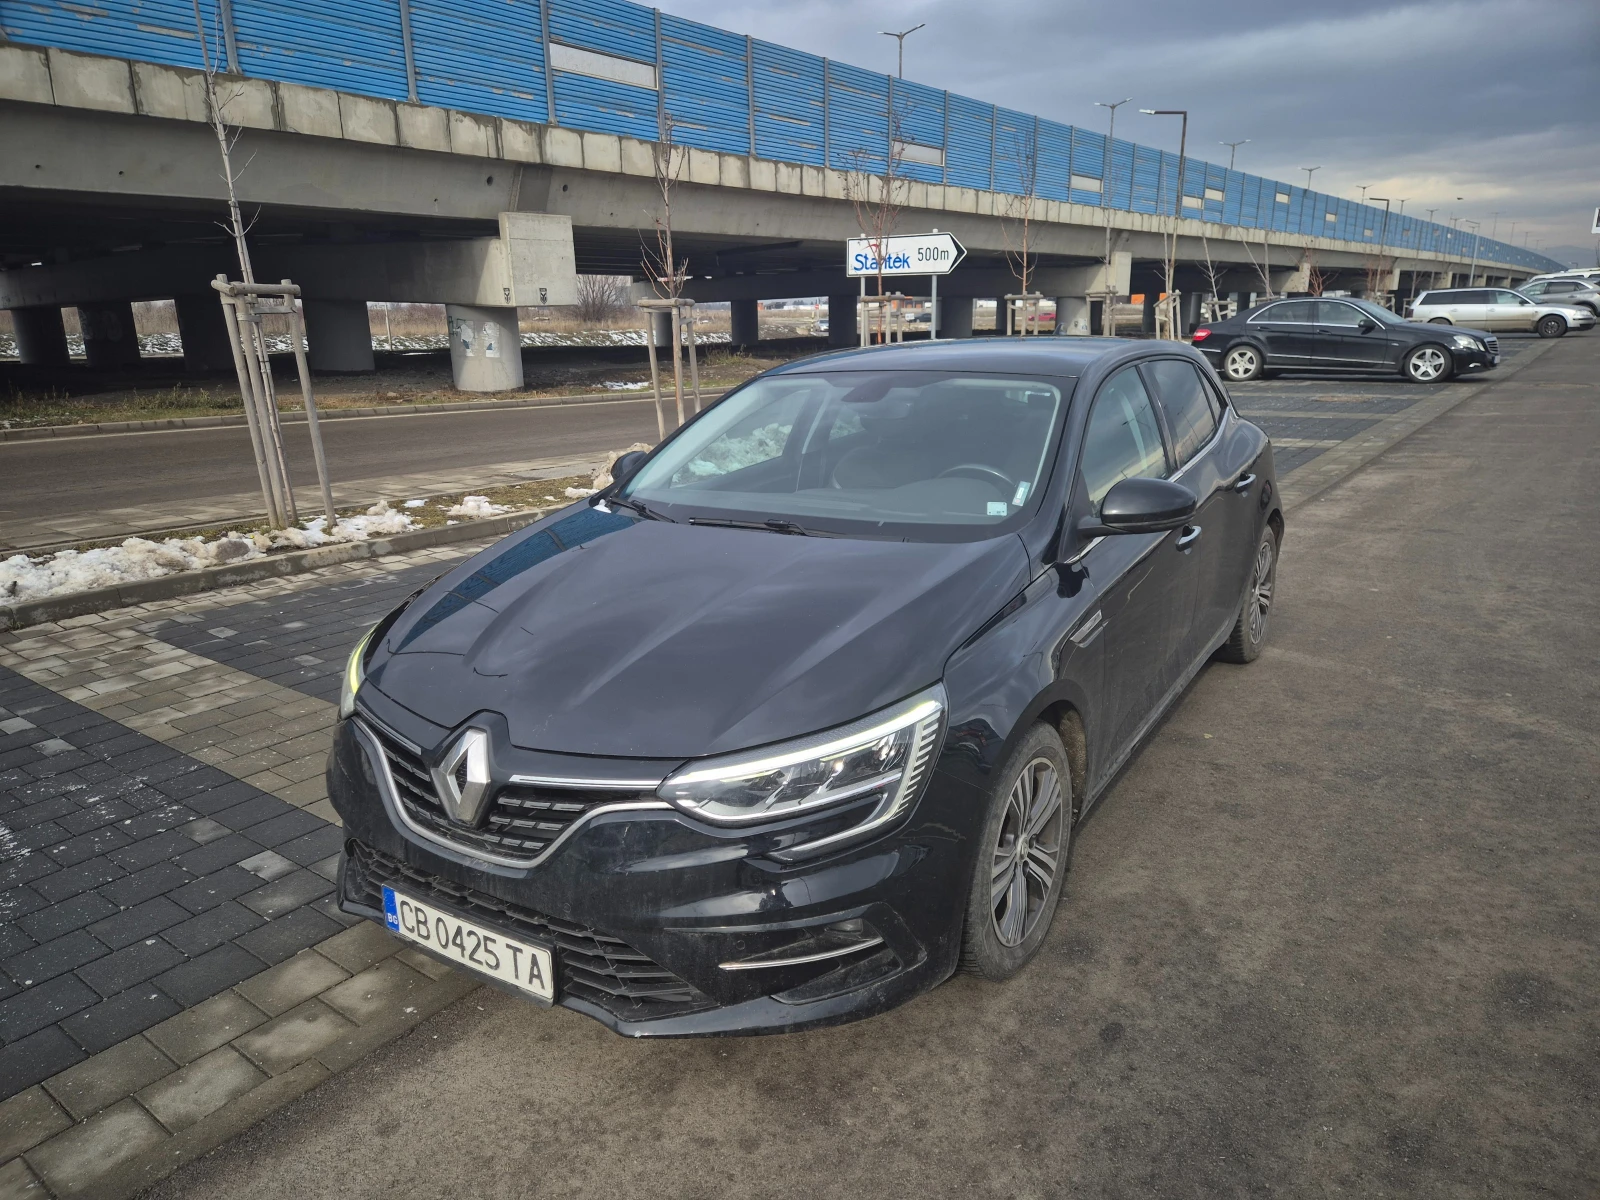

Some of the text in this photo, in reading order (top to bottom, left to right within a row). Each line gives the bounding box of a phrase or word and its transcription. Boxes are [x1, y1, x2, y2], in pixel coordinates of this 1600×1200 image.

[918, 247, 949, 261] 500m
[388, 913, 398, 924] BG
[399, 900, 546, 990] CB 0425 TA
